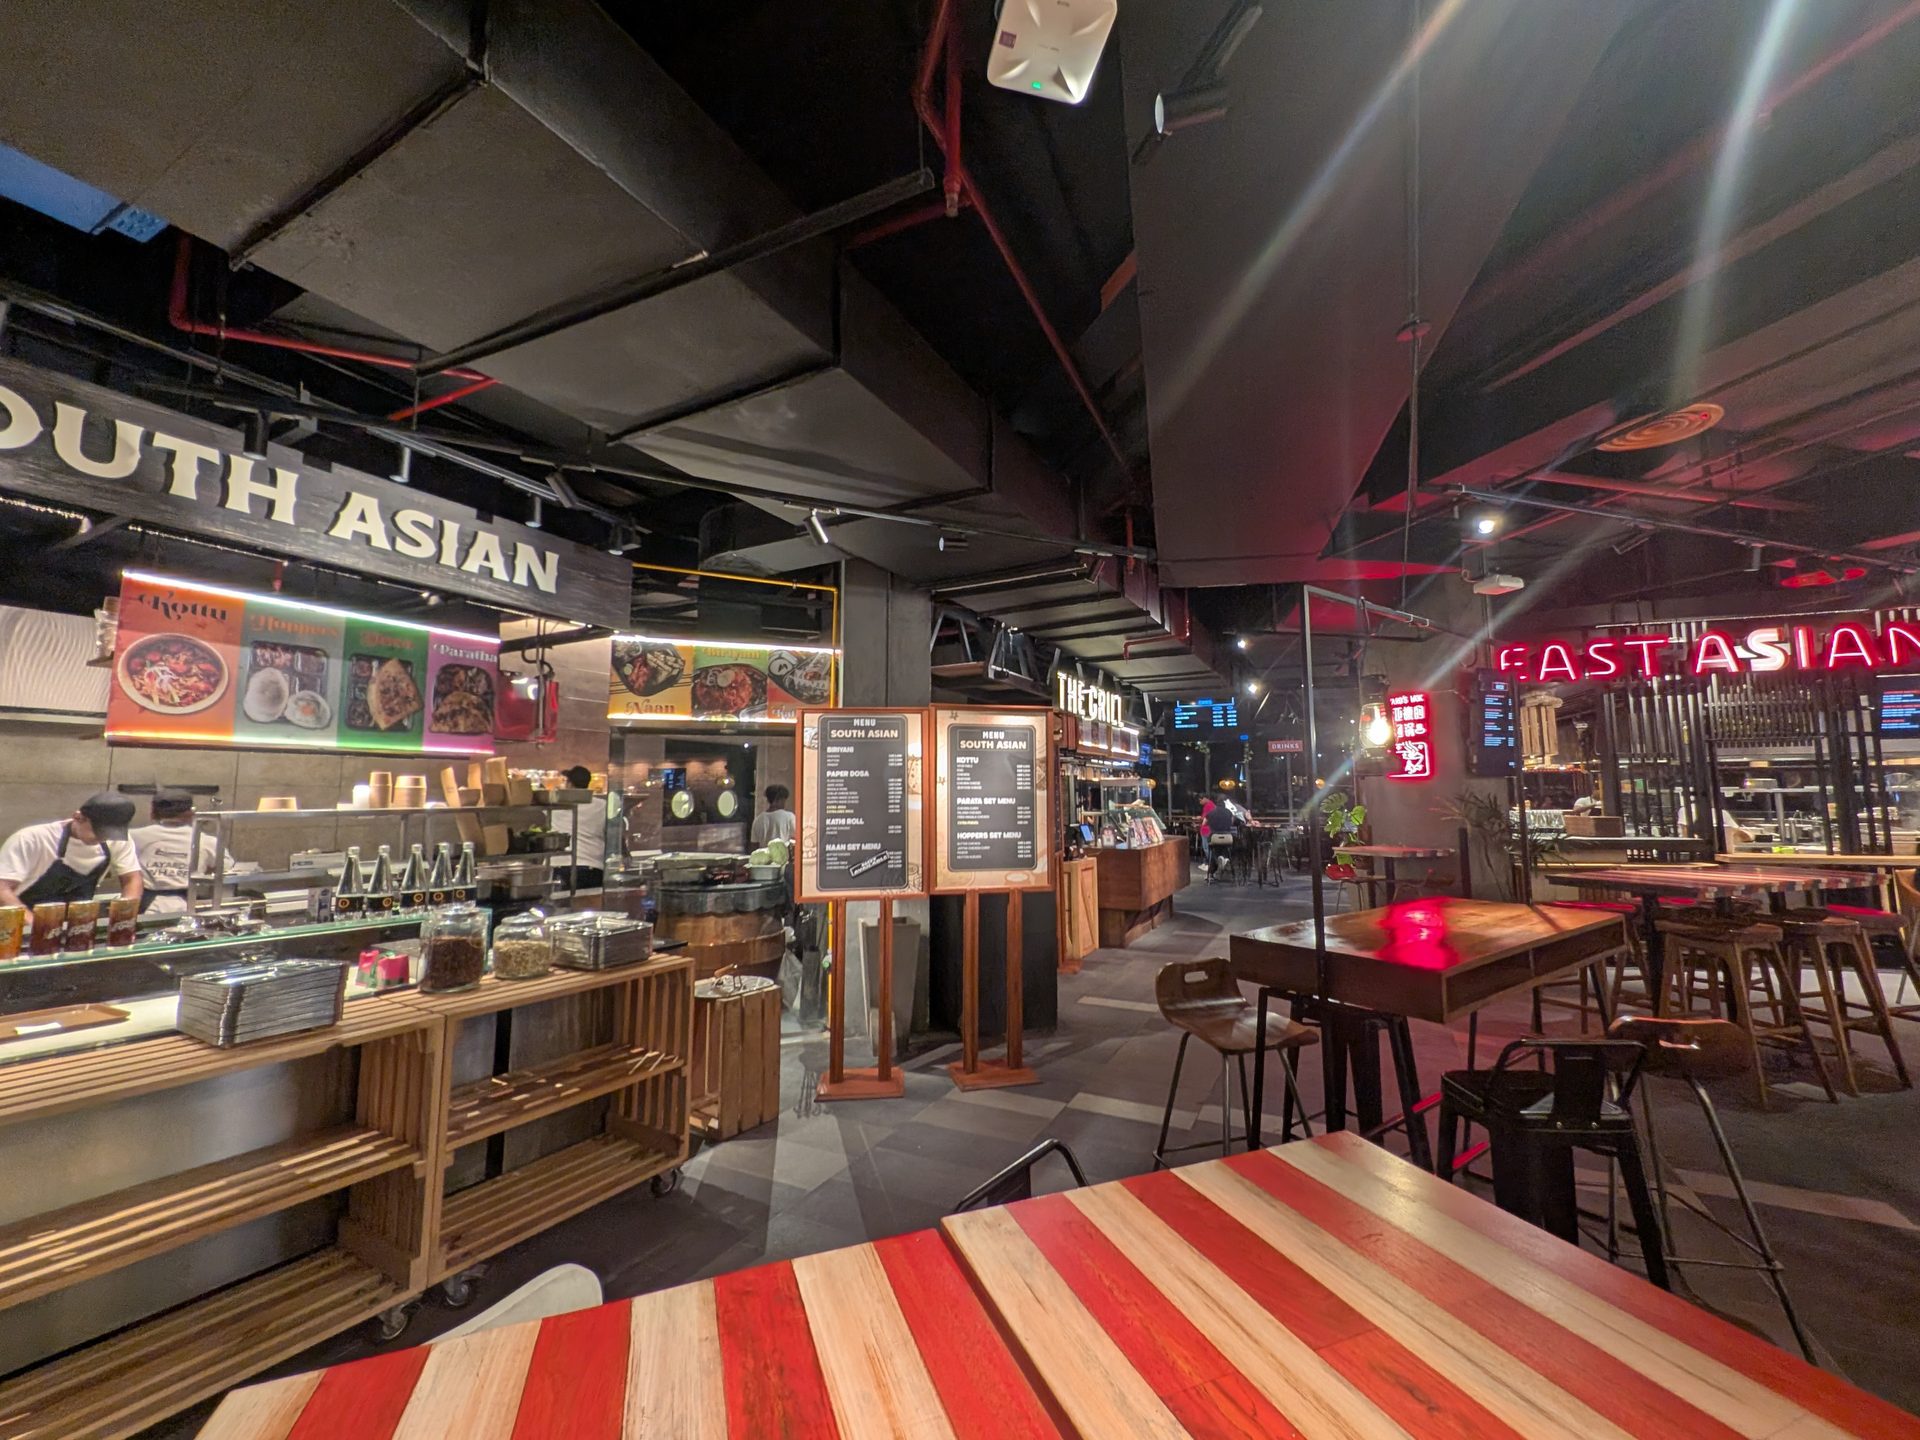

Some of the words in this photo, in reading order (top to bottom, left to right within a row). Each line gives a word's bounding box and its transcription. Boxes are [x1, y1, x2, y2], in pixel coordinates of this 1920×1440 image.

[327, 491, 560, 594] ASIAN
[433, 643, 498, 663] Paratha
[1499, 637, 1669, 683] EAST
[1694, 621, 1920, 675] ASIAN
[1056, 670, 1086, 717] THE
[624, 699, 675, 715] Naan
[853, 718, 876, 727] MENU
[830, 729, 865, 738] SOUTH
[867, 729, 898, 738] ASIAN
[982, 731, 1005, 739] MENU
[960, 740, 994, 749] SOUTH
[996, 740, 1027, 749] ASIAN
